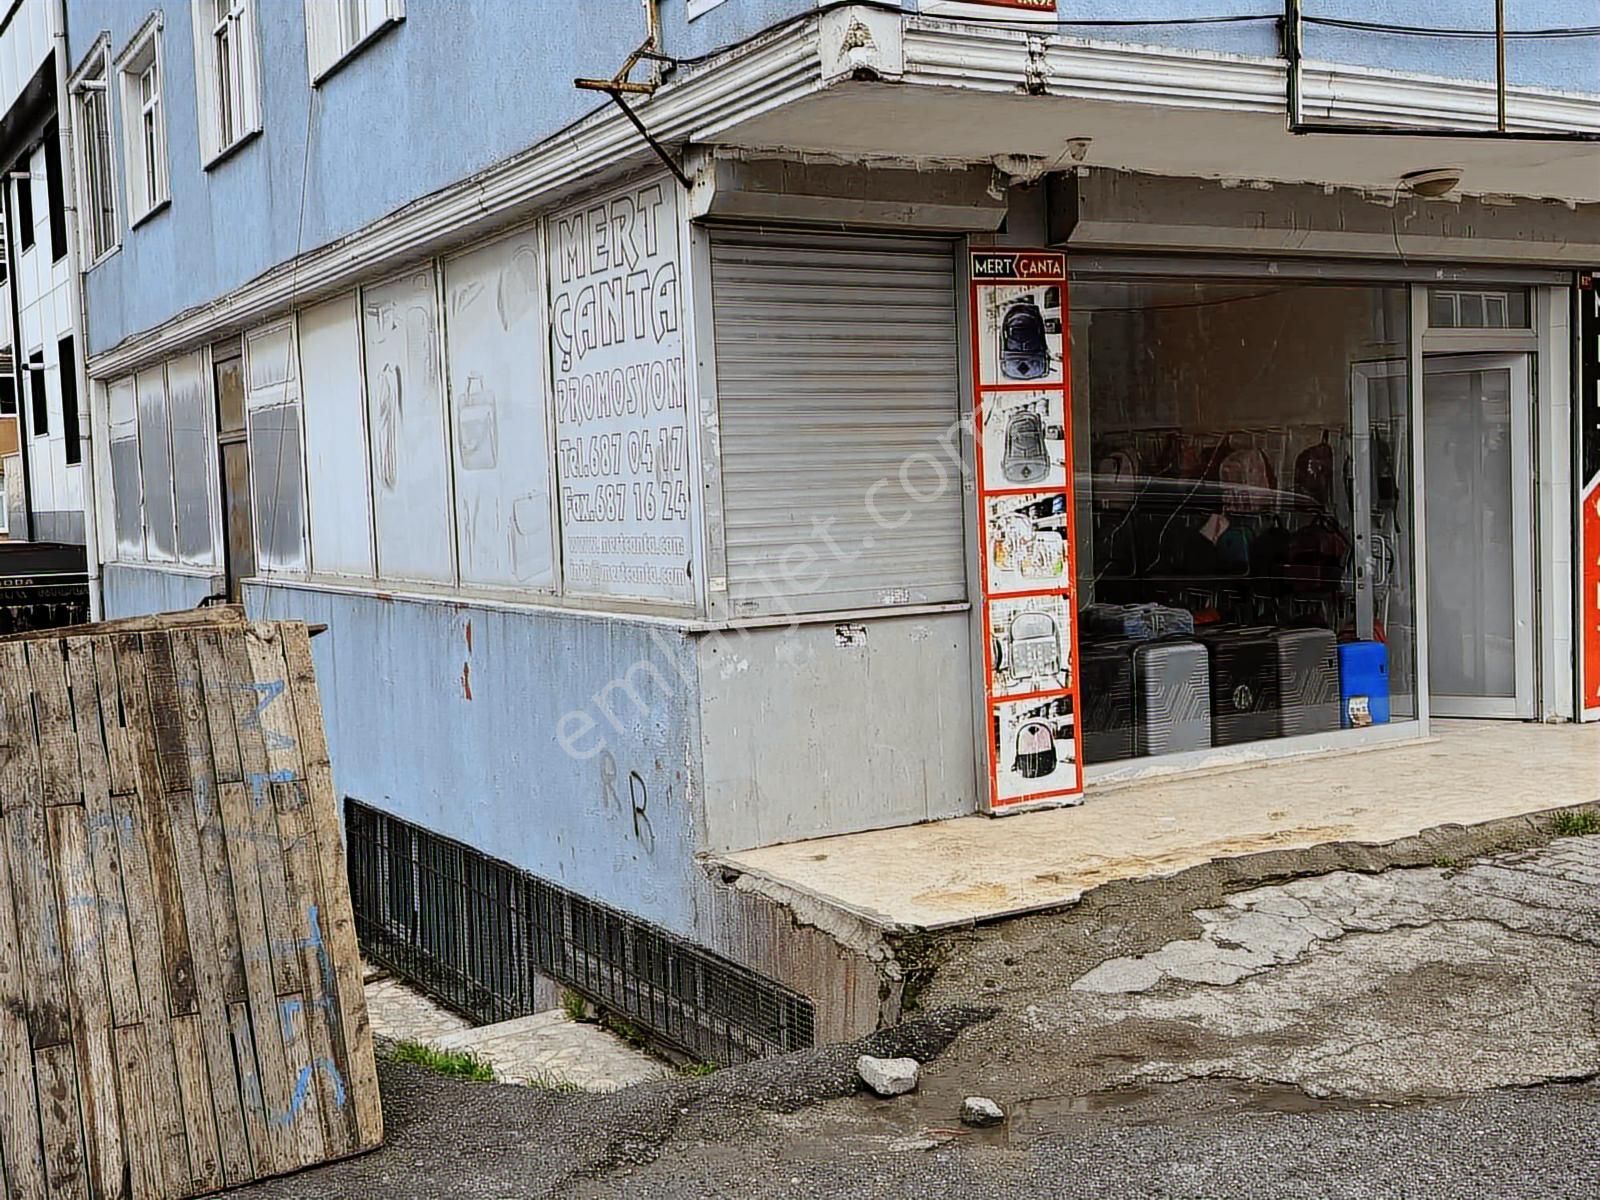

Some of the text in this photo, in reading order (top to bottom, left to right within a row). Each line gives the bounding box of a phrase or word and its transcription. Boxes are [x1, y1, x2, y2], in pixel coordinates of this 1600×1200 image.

[559, 183, 663, 284] MERT
[975, 258, 1061, 278] MERT ÇANTA
[553, 261, 678, 372] ÇANTA
[556, 357, 683, 427] PROMOSYON
[628, 430, 653, 474] 04
[659, 426, 683, 471] 17
[633, 482, 656, 521] 16
[662, 480, 686, 520] 24
